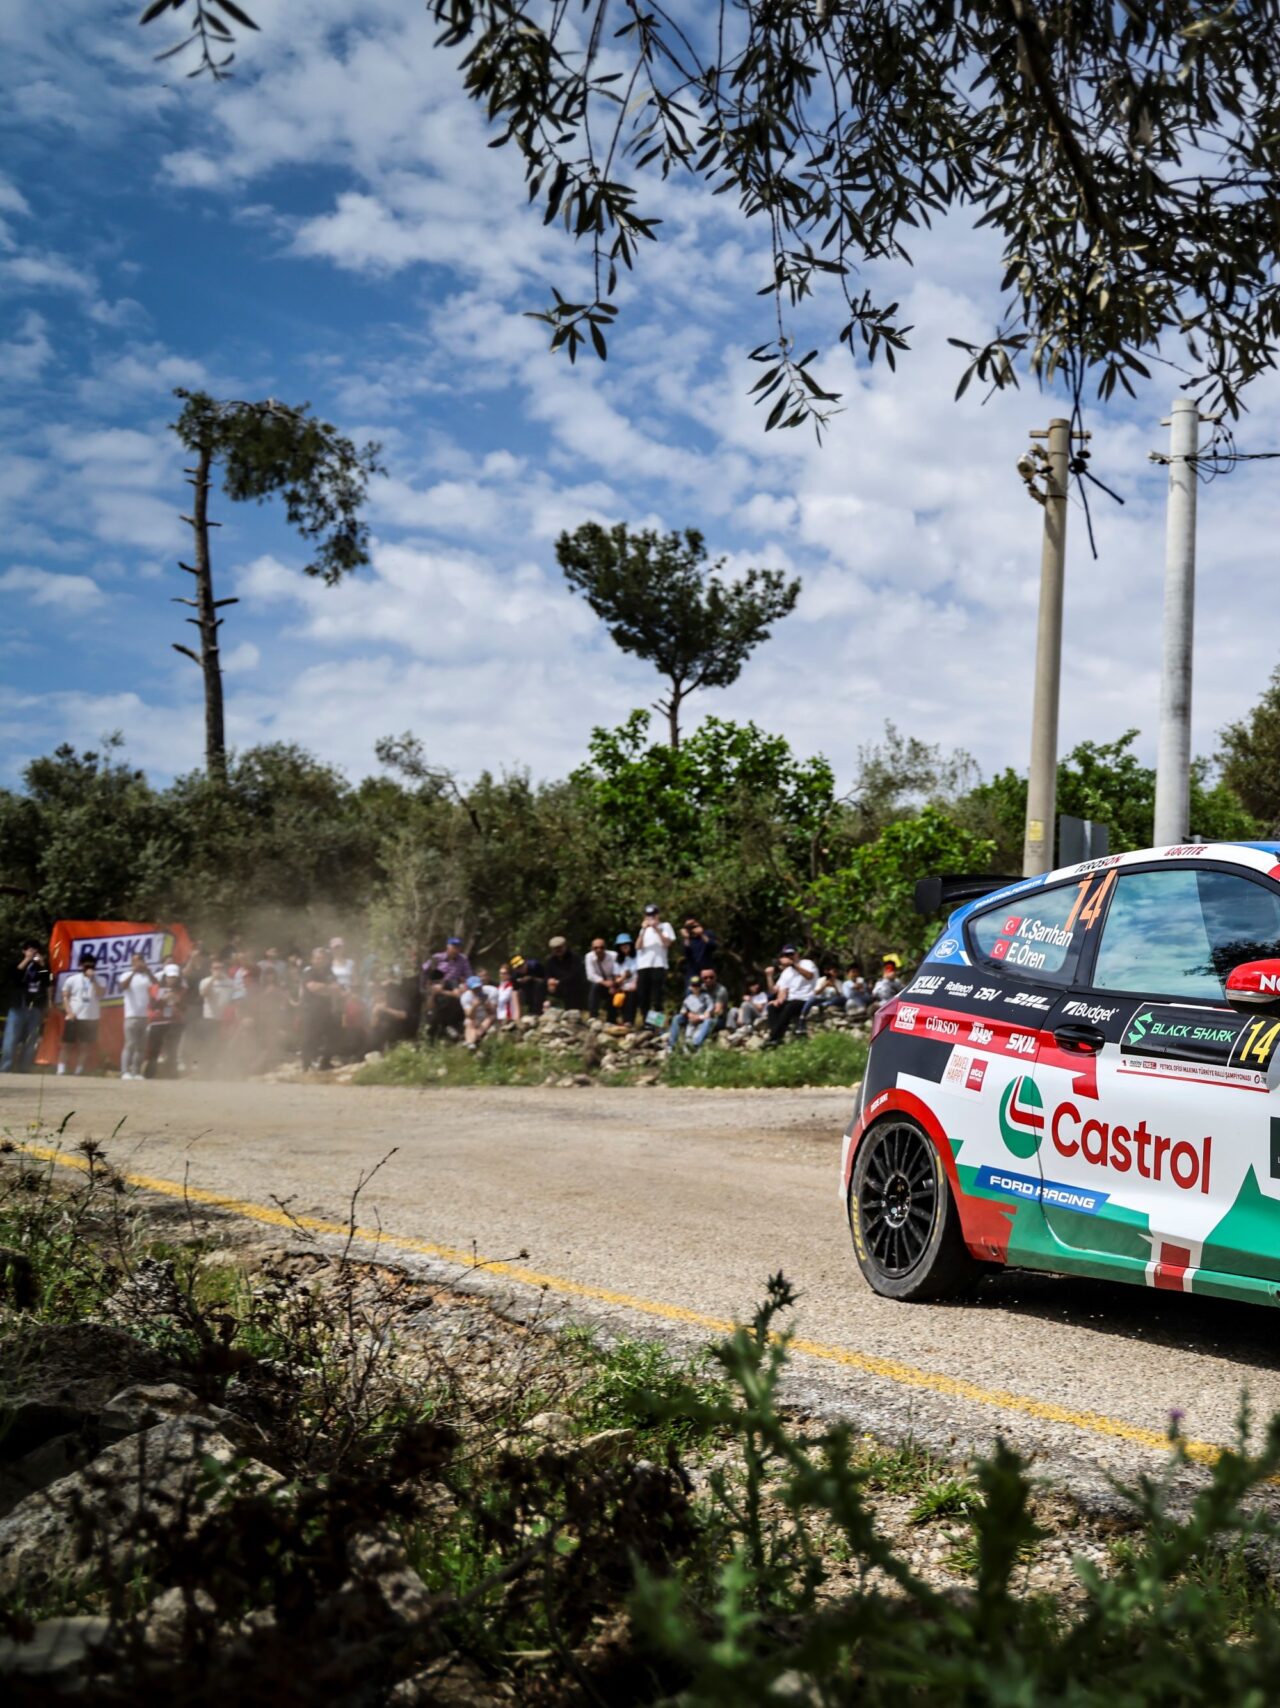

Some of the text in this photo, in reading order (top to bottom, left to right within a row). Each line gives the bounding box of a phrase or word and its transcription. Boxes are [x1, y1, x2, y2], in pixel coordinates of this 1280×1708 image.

[1064, 868, 1118, 932] 14
[1005, 940, 1046, 970] E.Ören
[973, 987, 1002, 1002] DSV
[1006, 992, 1050, 1011] DHL
[1075, 1002, 1116, 1024] Budget
[925, 1015, 960, 1036] GÜRSOY
[1150, 1022, 1238, 1043] BLACK SHARK
[1005, 1032, 1036, 1054] SKIL
[1051, 1101, 1212, 1195] Castrol
[990, 1174, 1096, 1210] FORD RACING
